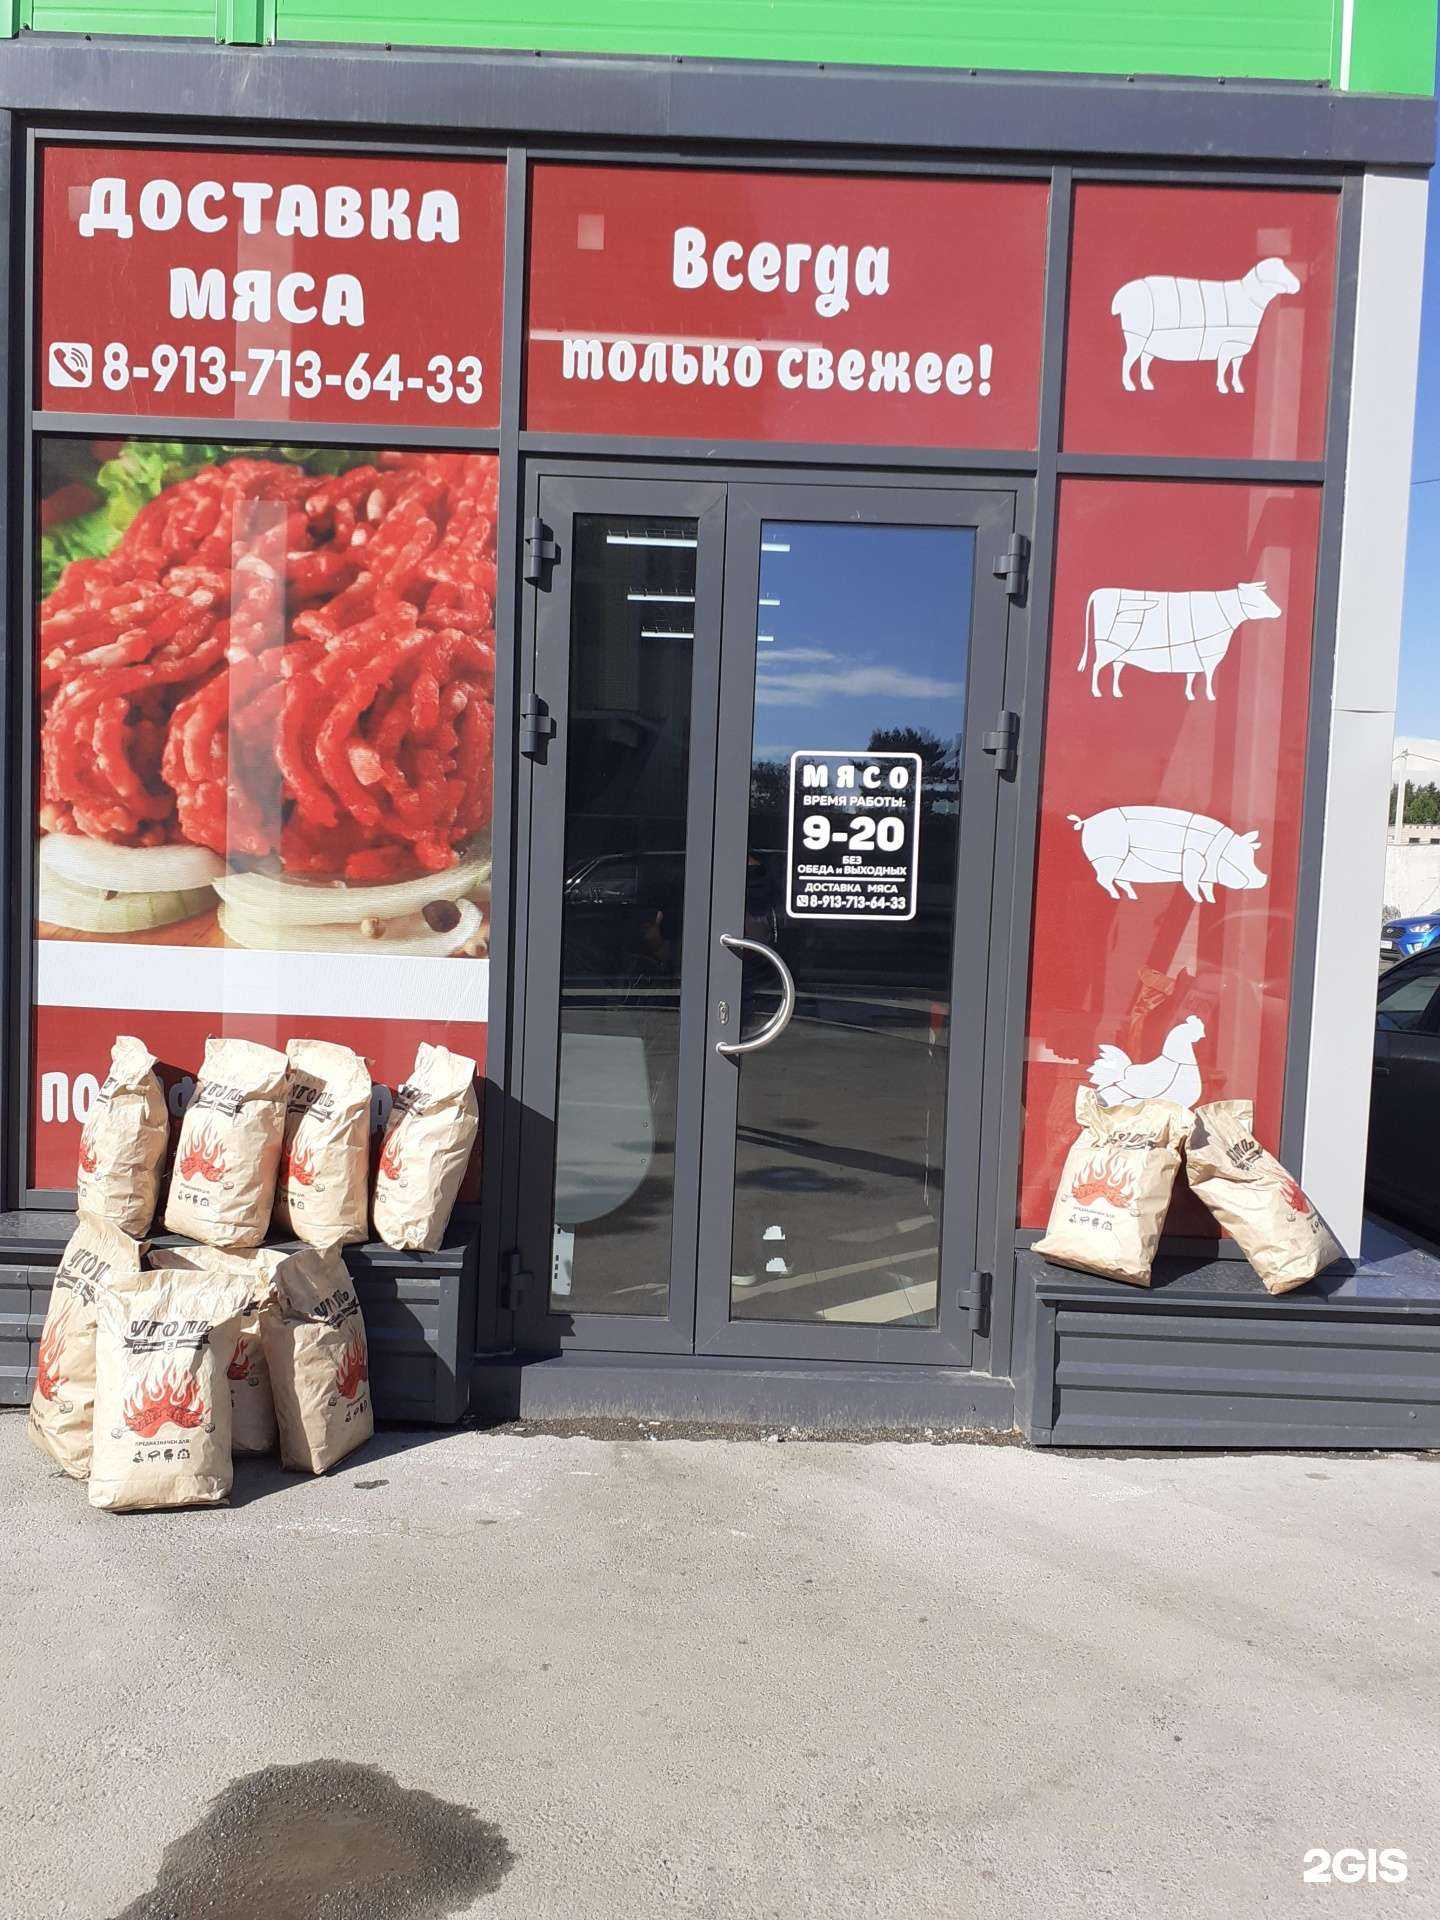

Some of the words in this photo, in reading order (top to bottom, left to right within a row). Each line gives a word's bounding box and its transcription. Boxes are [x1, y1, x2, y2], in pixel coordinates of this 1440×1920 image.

[79, 177, 460, 243] ДОСТАВКА
[672, 225, 890, 318] Всегда
[169, 267, 365, 326] МЯСА
[102, 342, 483, 404] 8-913-713-64-33
[562, 337, 763, 388] только
[777, 343, 993, 396] свежее!
[803, 795, 847, 806] ВРЕМЯ
[849, 796, 906, 808] РАБОТЫ:
[802, 815, 905, 852] 9-20
[797, 864, 834, 875] ОБЕДА
[843, 865, 907, 876] ВЫХОДНЫХ
[842, 855, 862, 865] БЕЗ
[804, 882, 862, 893] ДОСТАВКА
[867, 884, 899, 893] МЯСА
[810, 895, 906, 909] 8-913-713-64-33
[130, 1320, 214, 1337] УГОЛЬ
